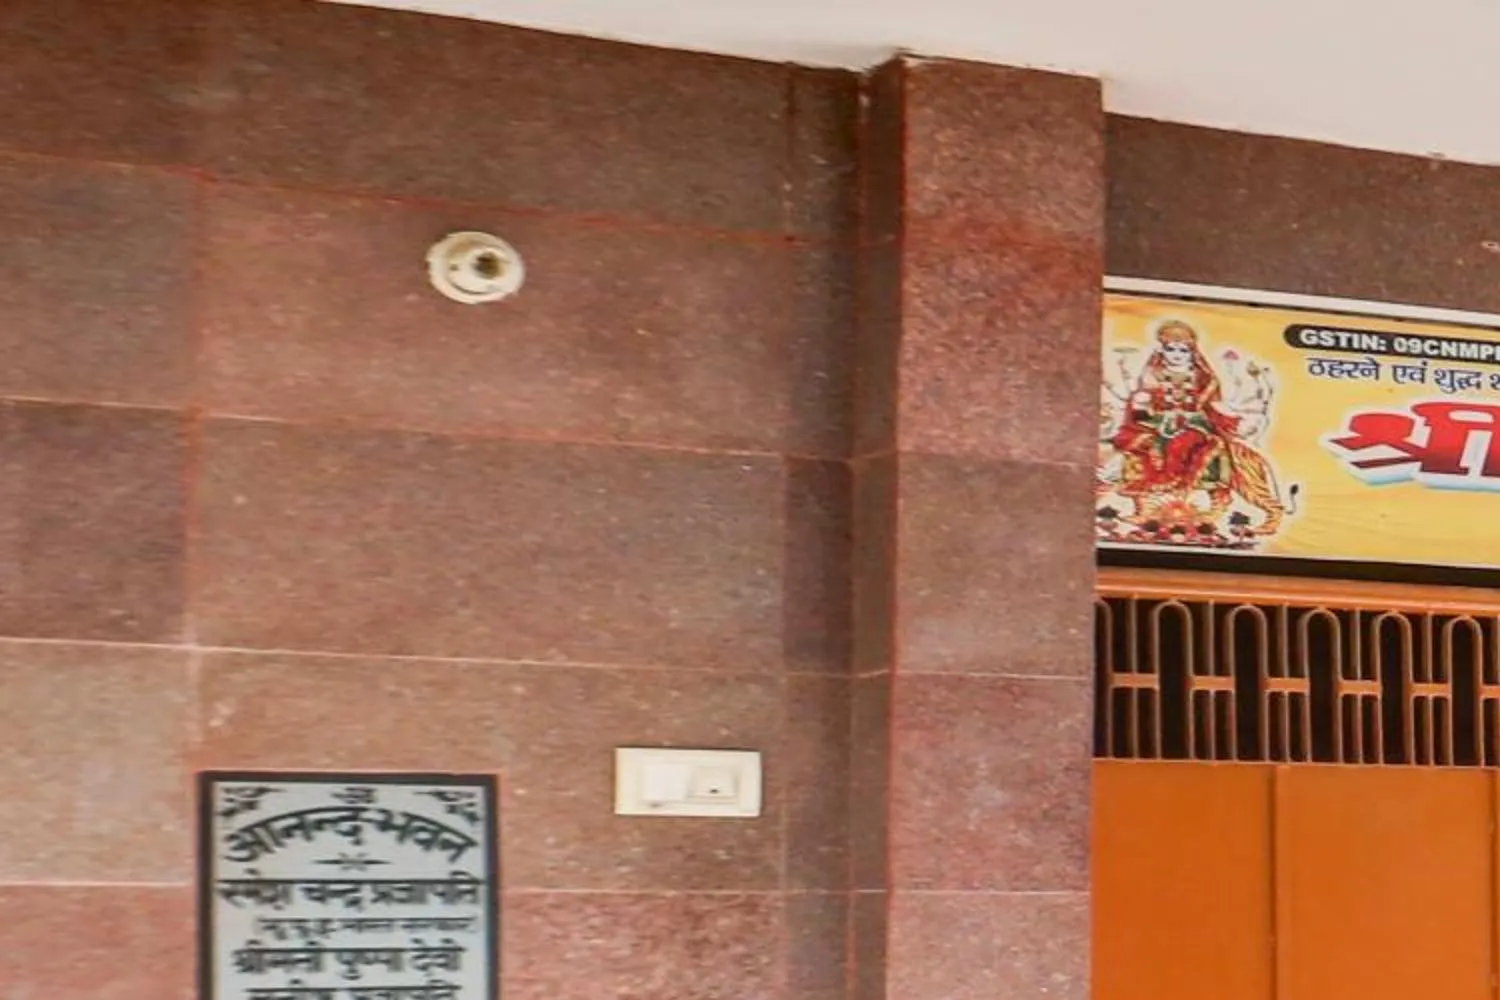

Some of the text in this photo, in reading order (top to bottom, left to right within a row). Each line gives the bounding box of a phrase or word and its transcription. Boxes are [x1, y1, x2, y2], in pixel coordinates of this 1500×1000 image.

[1300, 329, 1388, 350] GSTIN:
[1307, 356, 1380, 382] ठहरने
[1391, 361, 1427, 385] एवं
[1433, 370, 1482, 394] शुद्ध
